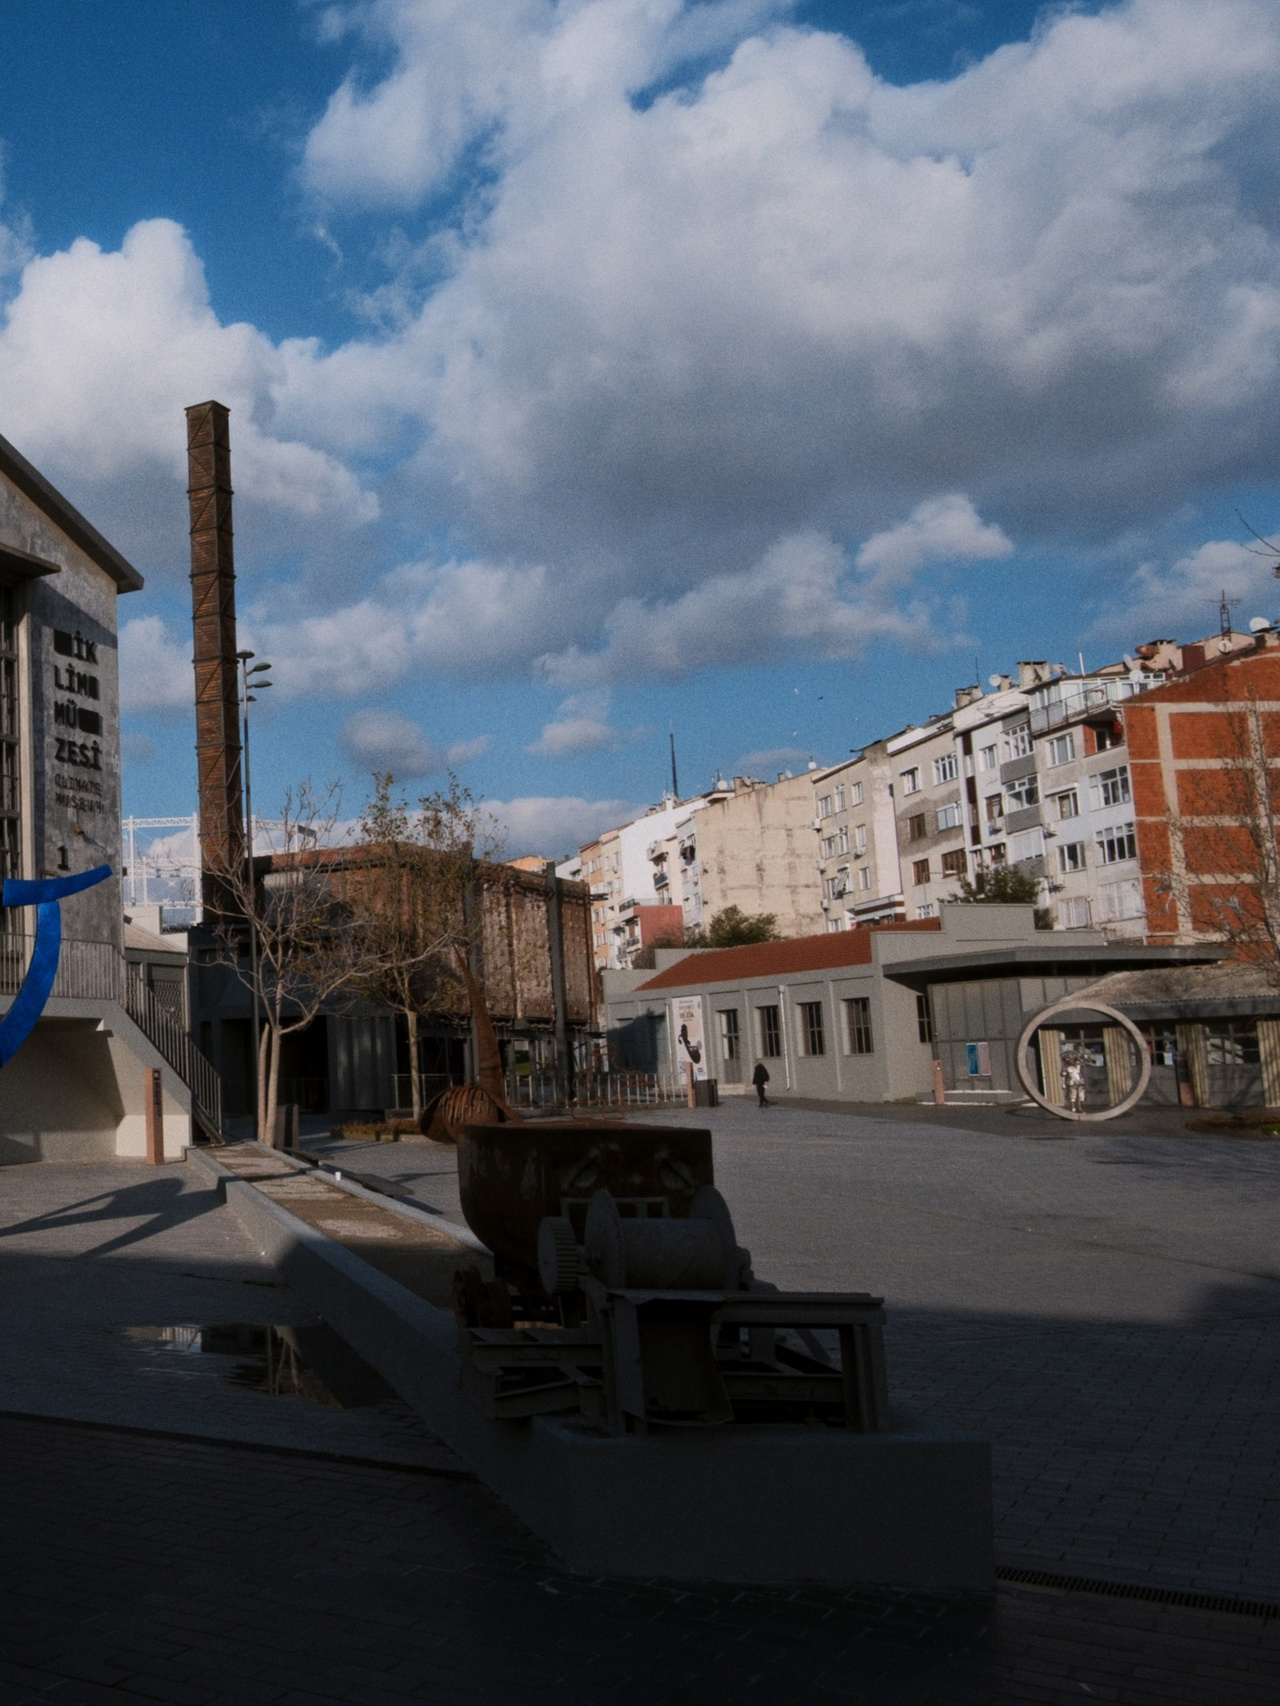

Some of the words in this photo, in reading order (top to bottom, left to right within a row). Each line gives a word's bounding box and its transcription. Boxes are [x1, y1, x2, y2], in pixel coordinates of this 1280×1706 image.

[74, 630, 98, 665] İK
[54, 663, 89, 697] LİM
[54, 698, 77, 729] MÜ
[54, 737, 102, 771] ZESİ
[54, 773, 103, 797] CLIMATE
[54, 792, 105, 815] MUSEUM
[58, 845, 69, 871] 1
